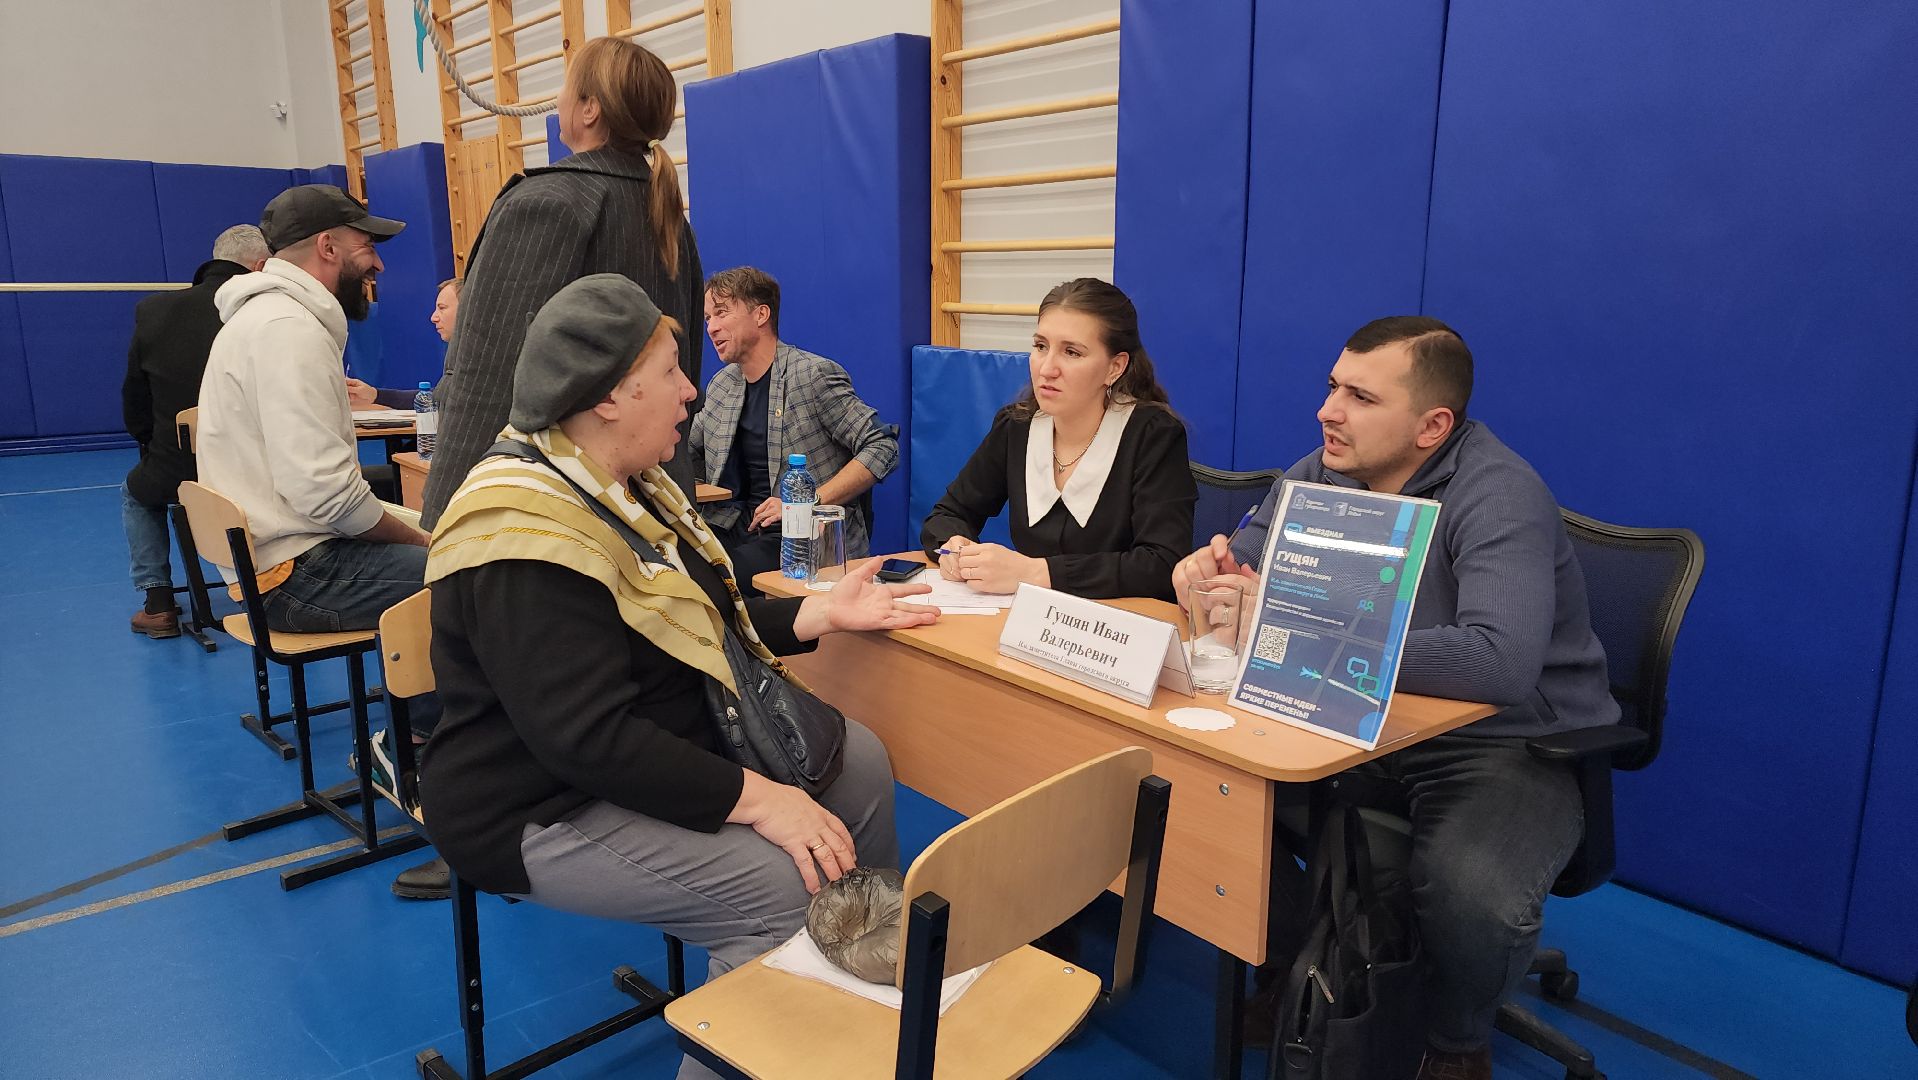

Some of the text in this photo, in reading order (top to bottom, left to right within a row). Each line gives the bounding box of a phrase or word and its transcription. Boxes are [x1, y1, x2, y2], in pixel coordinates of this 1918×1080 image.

[1306, 526, 1345, 539] ВЫЕЗДНАЯ
[1276, 550, 1319, 568] ГУЩЯН
[1273, 563, 1332, 581] Иван Валерьевич
[1044, 605, 1131, 645] Гущян Иван
[1039, 628, 1118, 668] Валерьевич
[1240, 691, 1265, 705] ЯРКИЕ
[1243, 683, 1294, 705] СОВМЕСТНЫЕ
[1293, 698, 1317, 712] ИДЕИ
